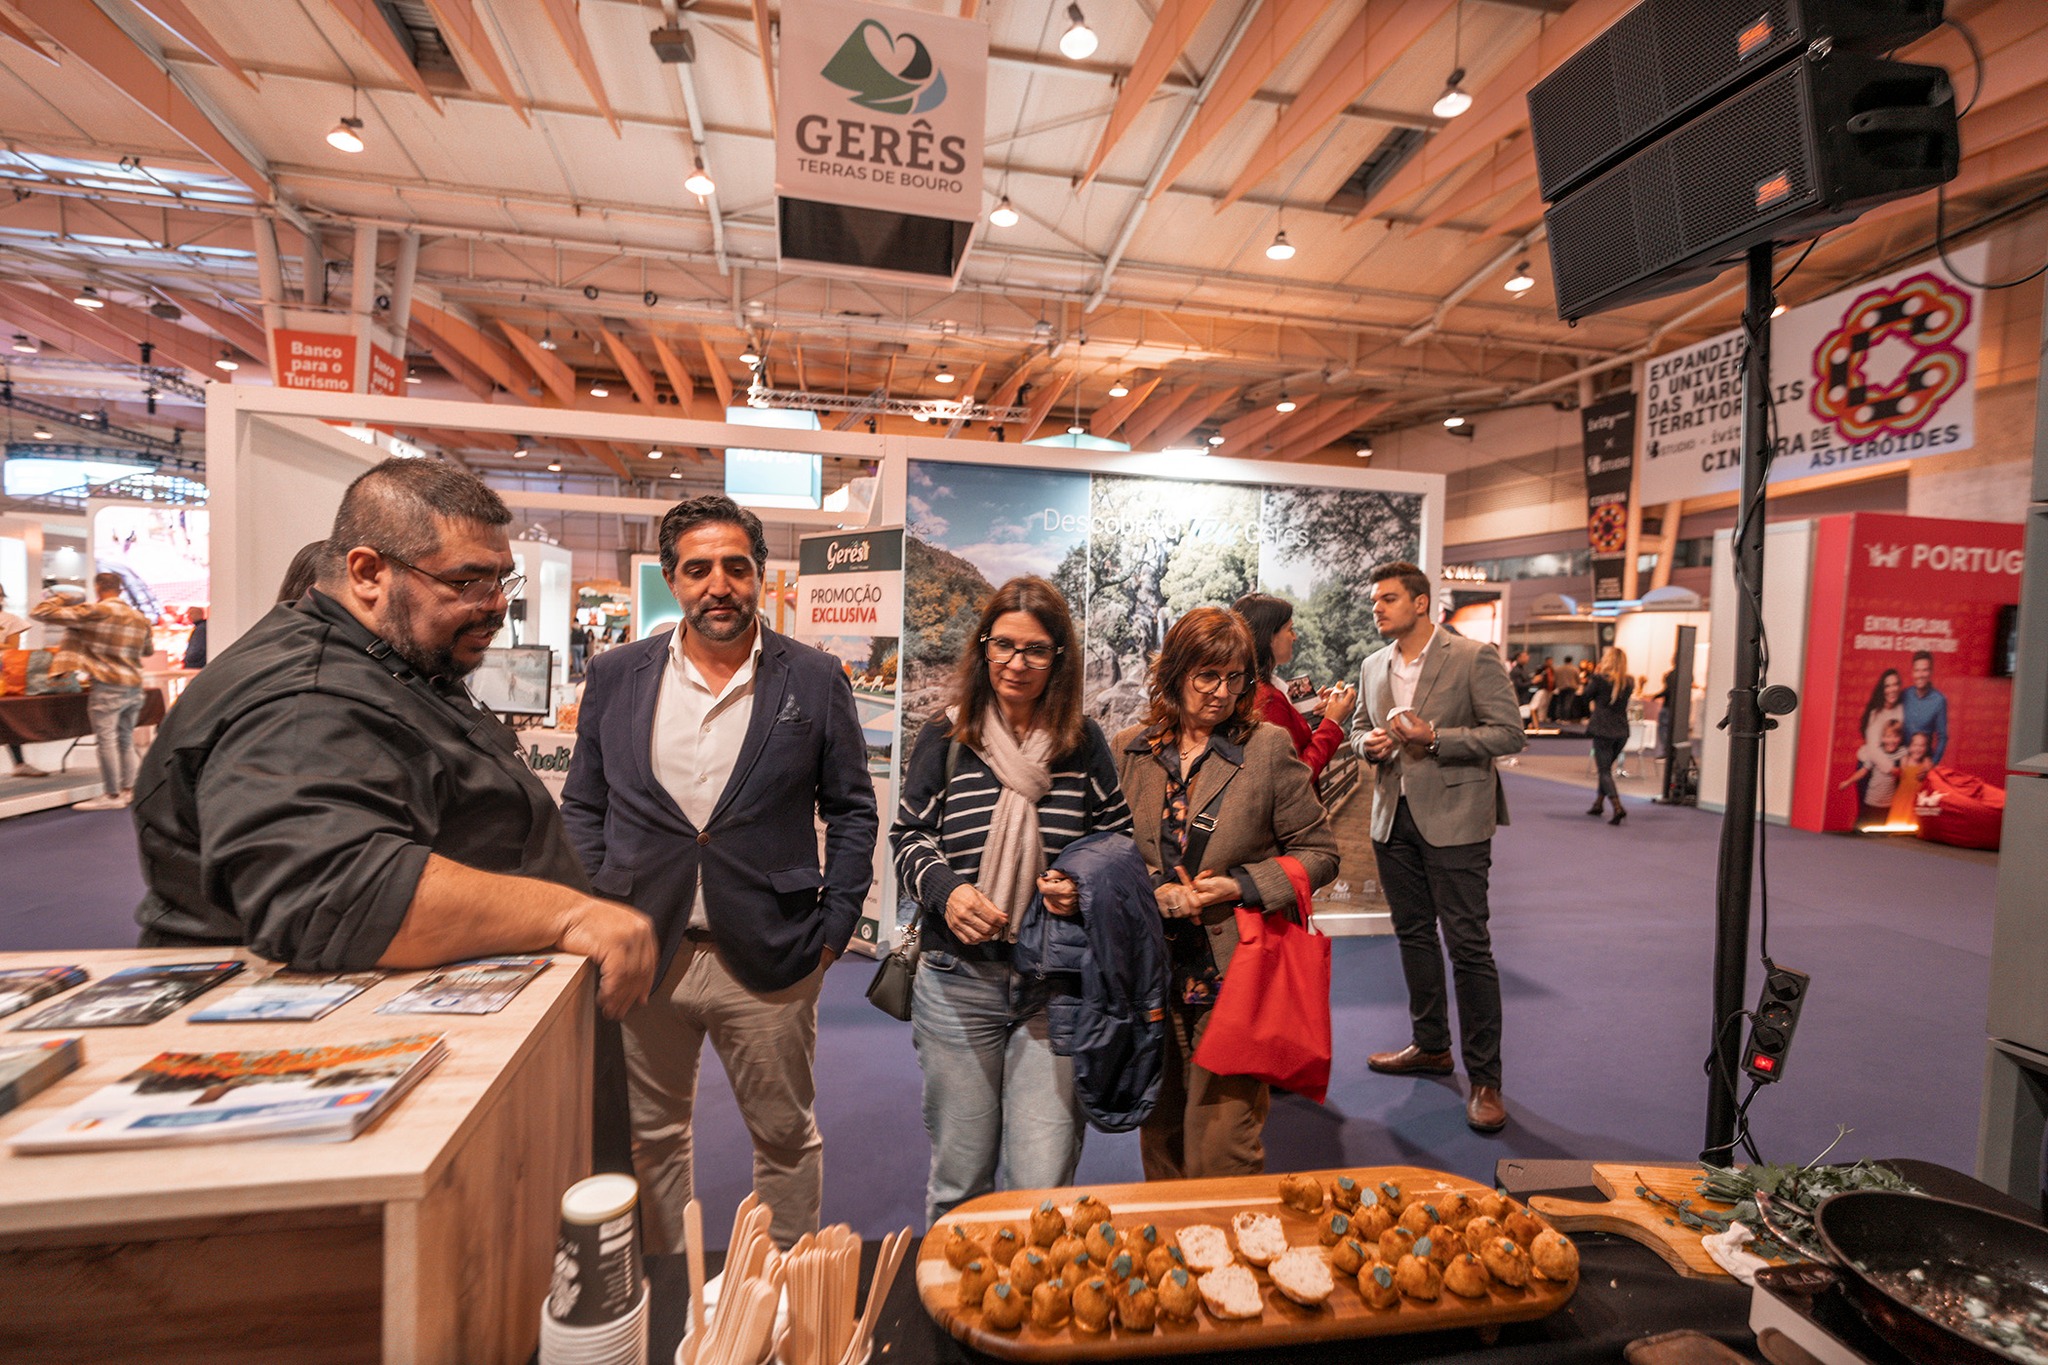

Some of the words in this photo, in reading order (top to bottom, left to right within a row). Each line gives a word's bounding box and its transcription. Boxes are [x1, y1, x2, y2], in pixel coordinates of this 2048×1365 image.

[796, 114, 966, 175] GERÊS
[798, 158, 867, 180] TERRAS
[872, 169, 895, 184] DE
[900, 173, 963, 193] BOURO
[291, 341, 342, 359] Banco
[284, 371, 349, 391] Turismo
[291, 359, 328, 373] para
[332, 363, 342, 374] o
[1650, 384, 1660, 400] O
[1669, 357, 1744, 394] UNIVER
[1650, 396, 1682, 419] DAS
[1693, 377, 1743, 407] MARC
[1702, 433, 1805, 472] CINRA
[1811, 427, 1831, 443] DE
[1811, 424, 1960, 469] ASTERÓIDES
[1911, 544, 2024, 575] PORTUG
[810, 583, 882, 605] PROMOÇÃO
[811, 606, 877, 623] EXCLUSIVA
[529, 744, 570, 772] holi
